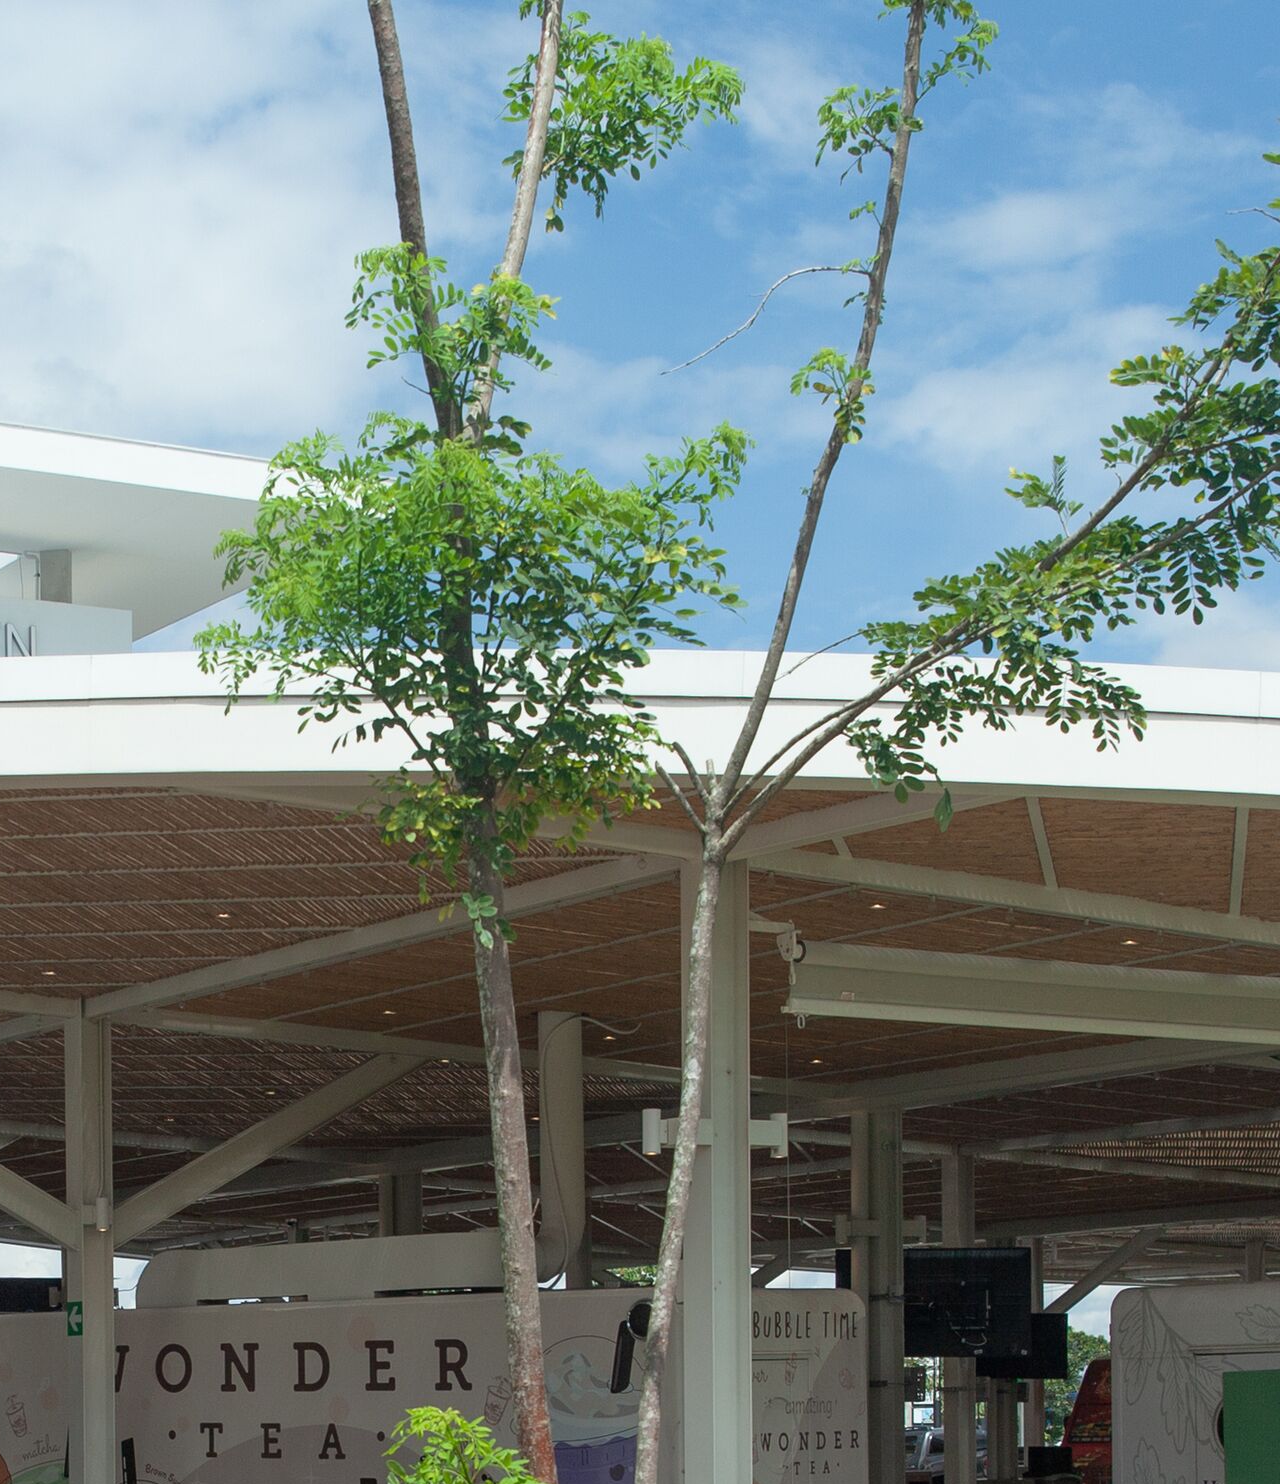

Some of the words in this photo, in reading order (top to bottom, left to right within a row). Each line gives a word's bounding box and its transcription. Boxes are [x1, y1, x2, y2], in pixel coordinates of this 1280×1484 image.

[753, 1310, 811, 1339] BUBBLE
[822, 1311, 858, 1340] TIME
[22, 1434, 61, 1462] matcha
[199, 1422, 347, 1460] TEA
[760, 1429, 860, 1452] WONDER
[144, 1463, 167, 1480] Brown
[792, 1460, 831, 1476] TEA
